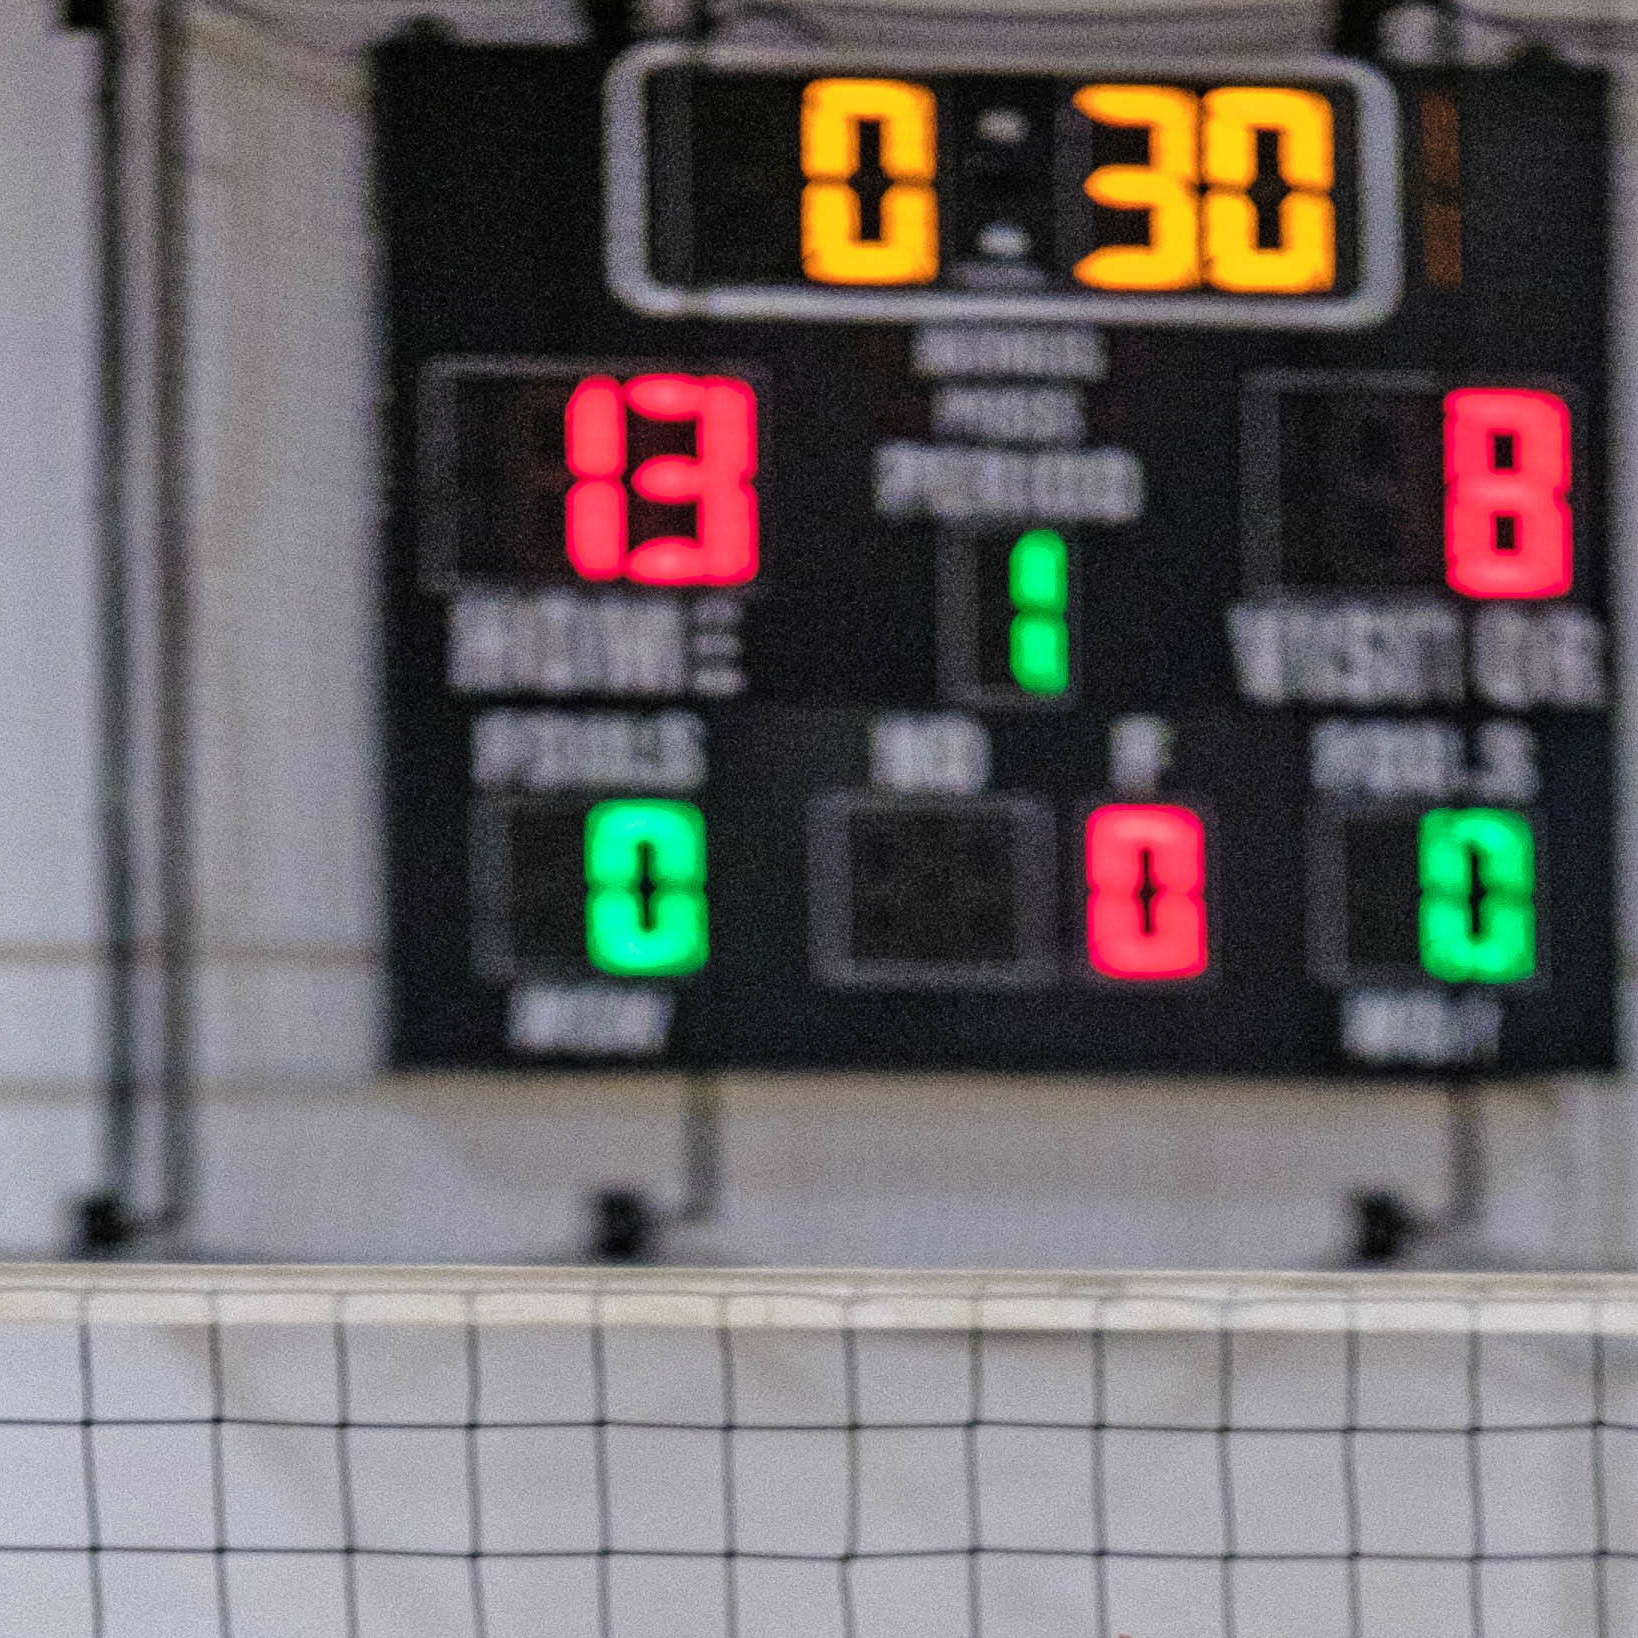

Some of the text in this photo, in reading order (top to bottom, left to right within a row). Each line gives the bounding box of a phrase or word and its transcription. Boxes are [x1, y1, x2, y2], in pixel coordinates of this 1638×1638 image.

[562, 371, 761, 588] 13
[1441, 386, 1575, 602] 8
[1008, 529, 1070, 695] 1
[583, 797, 710, 978] 0
[1083, 802, 1210, 983] 0
[1417, 806, 1536, 985] 0
